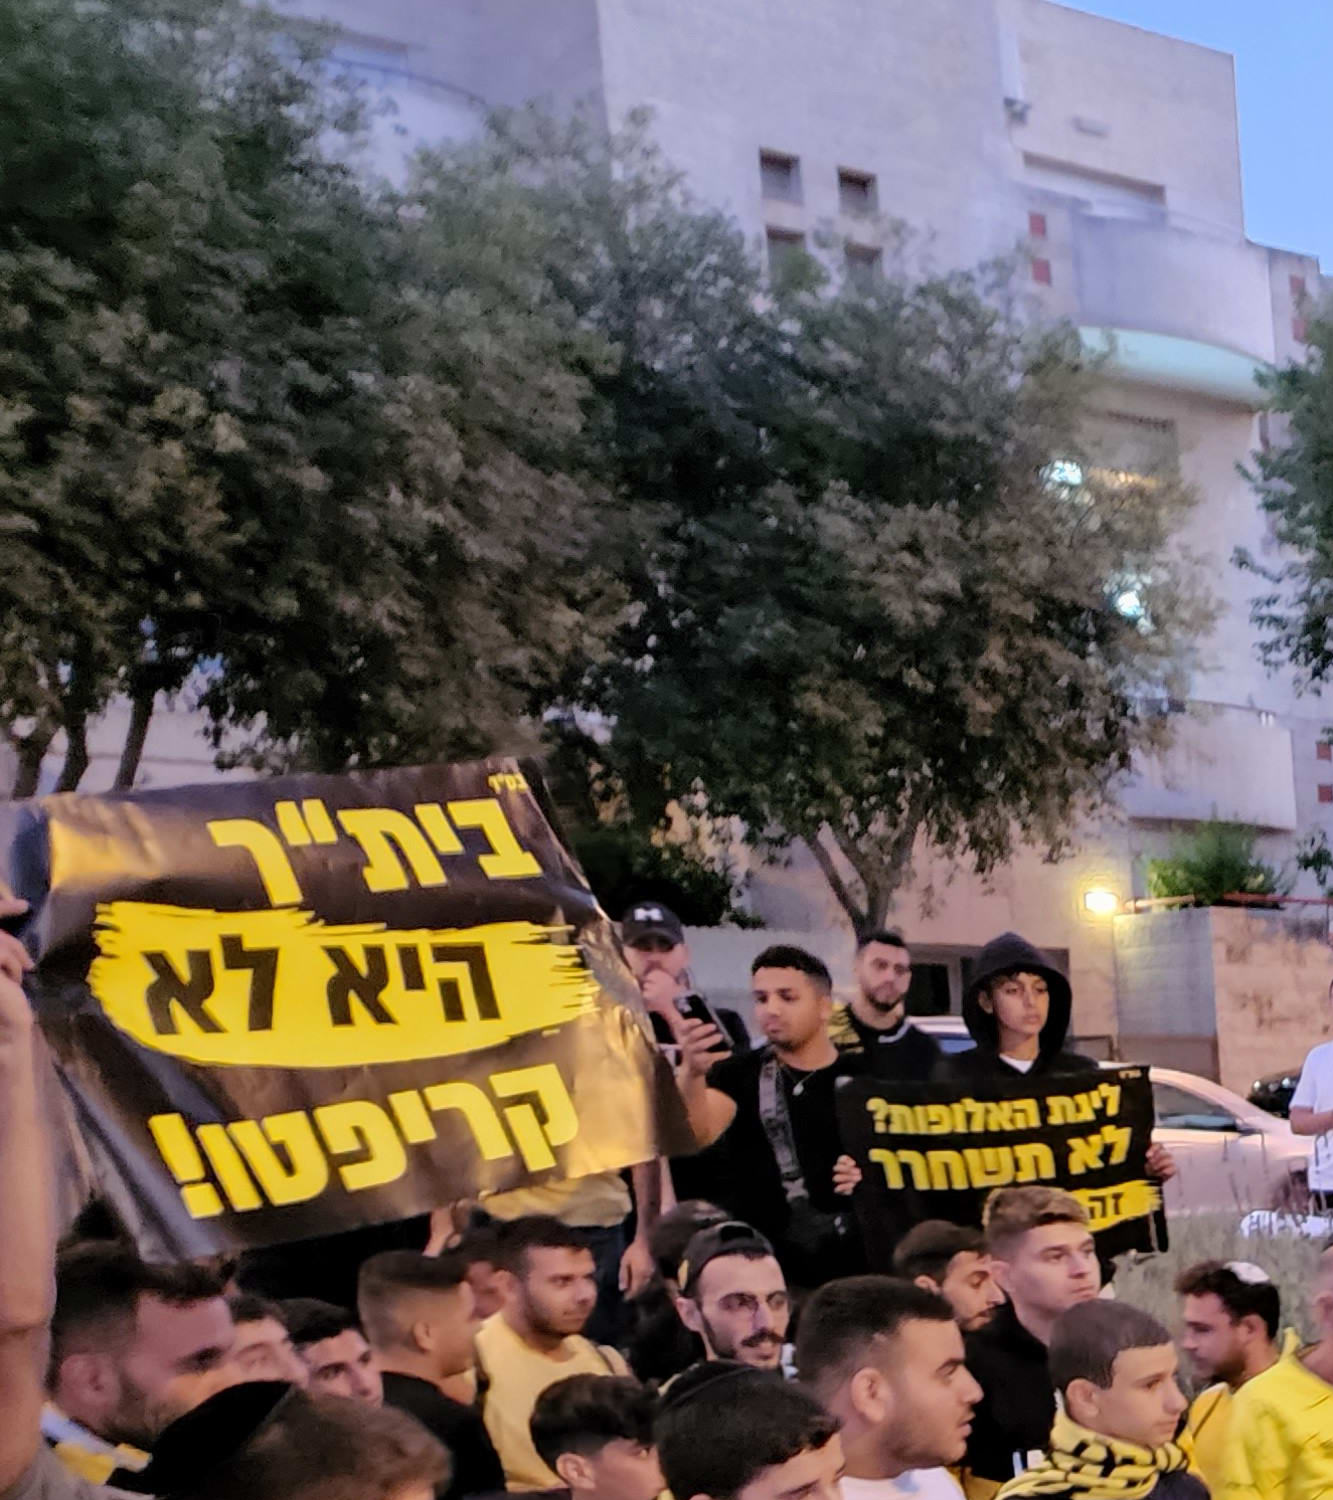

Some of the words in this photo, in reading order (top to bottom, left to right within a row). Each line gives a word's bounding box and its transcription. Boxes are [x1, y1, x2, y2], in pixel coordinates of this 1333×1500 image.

[207, 799, 542, 906] בית"ר
[142, 934, 281, 1034] לא
[321, 942, 501, 1027] היא
[866, 1097, 1042, 1135] האלופות?
[1046, 1083, 1121, 1126] ליגת
[149, 1063, 579, 1220] קריפטו!
[869, 1142, 1056, 1190] תשחרר
[1067, 1124, 1133, 1175] לא
